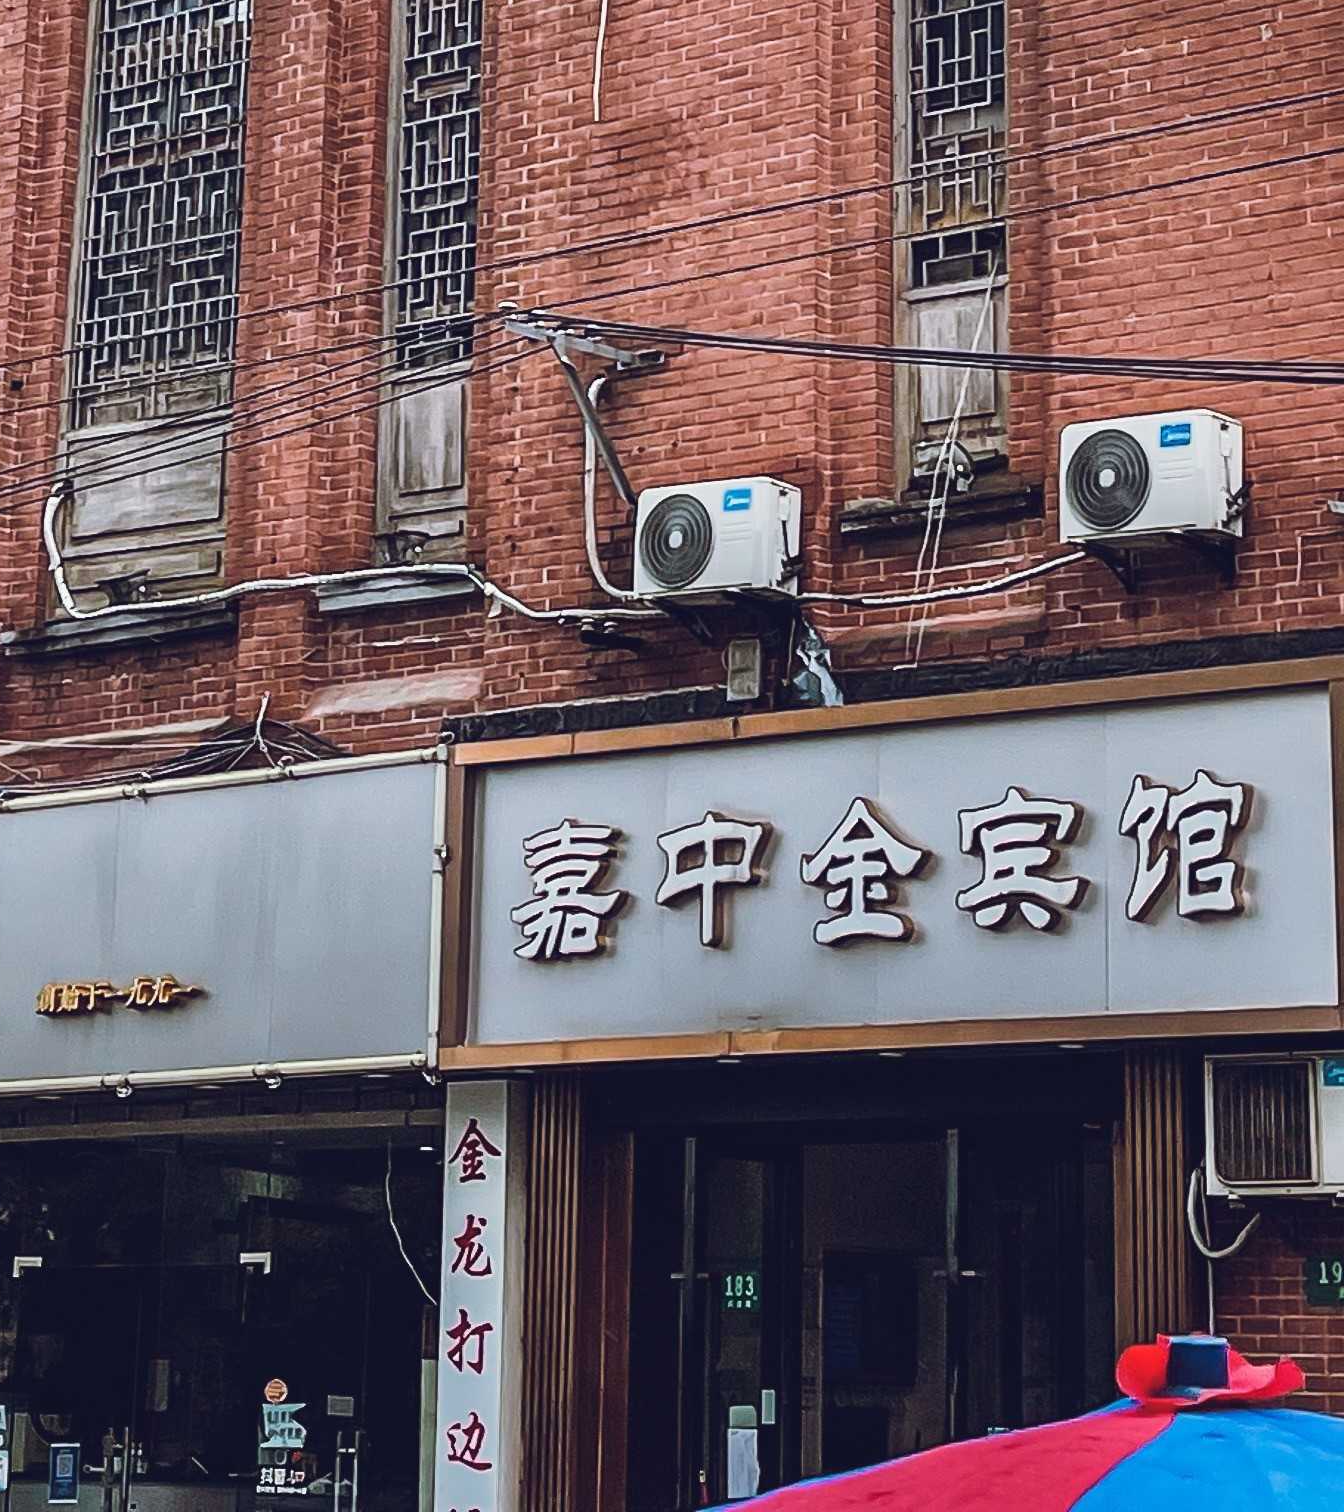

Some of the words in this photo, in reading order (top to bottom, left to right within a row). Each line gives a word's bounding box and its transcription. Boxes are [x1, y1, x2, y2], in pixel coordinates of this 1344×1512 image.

[510, 768, 1248, 962] 嘉中金宾馆
[445, 1118, 502, 1511] 金龙打边
[725, 1275, 754, 1296] 183
